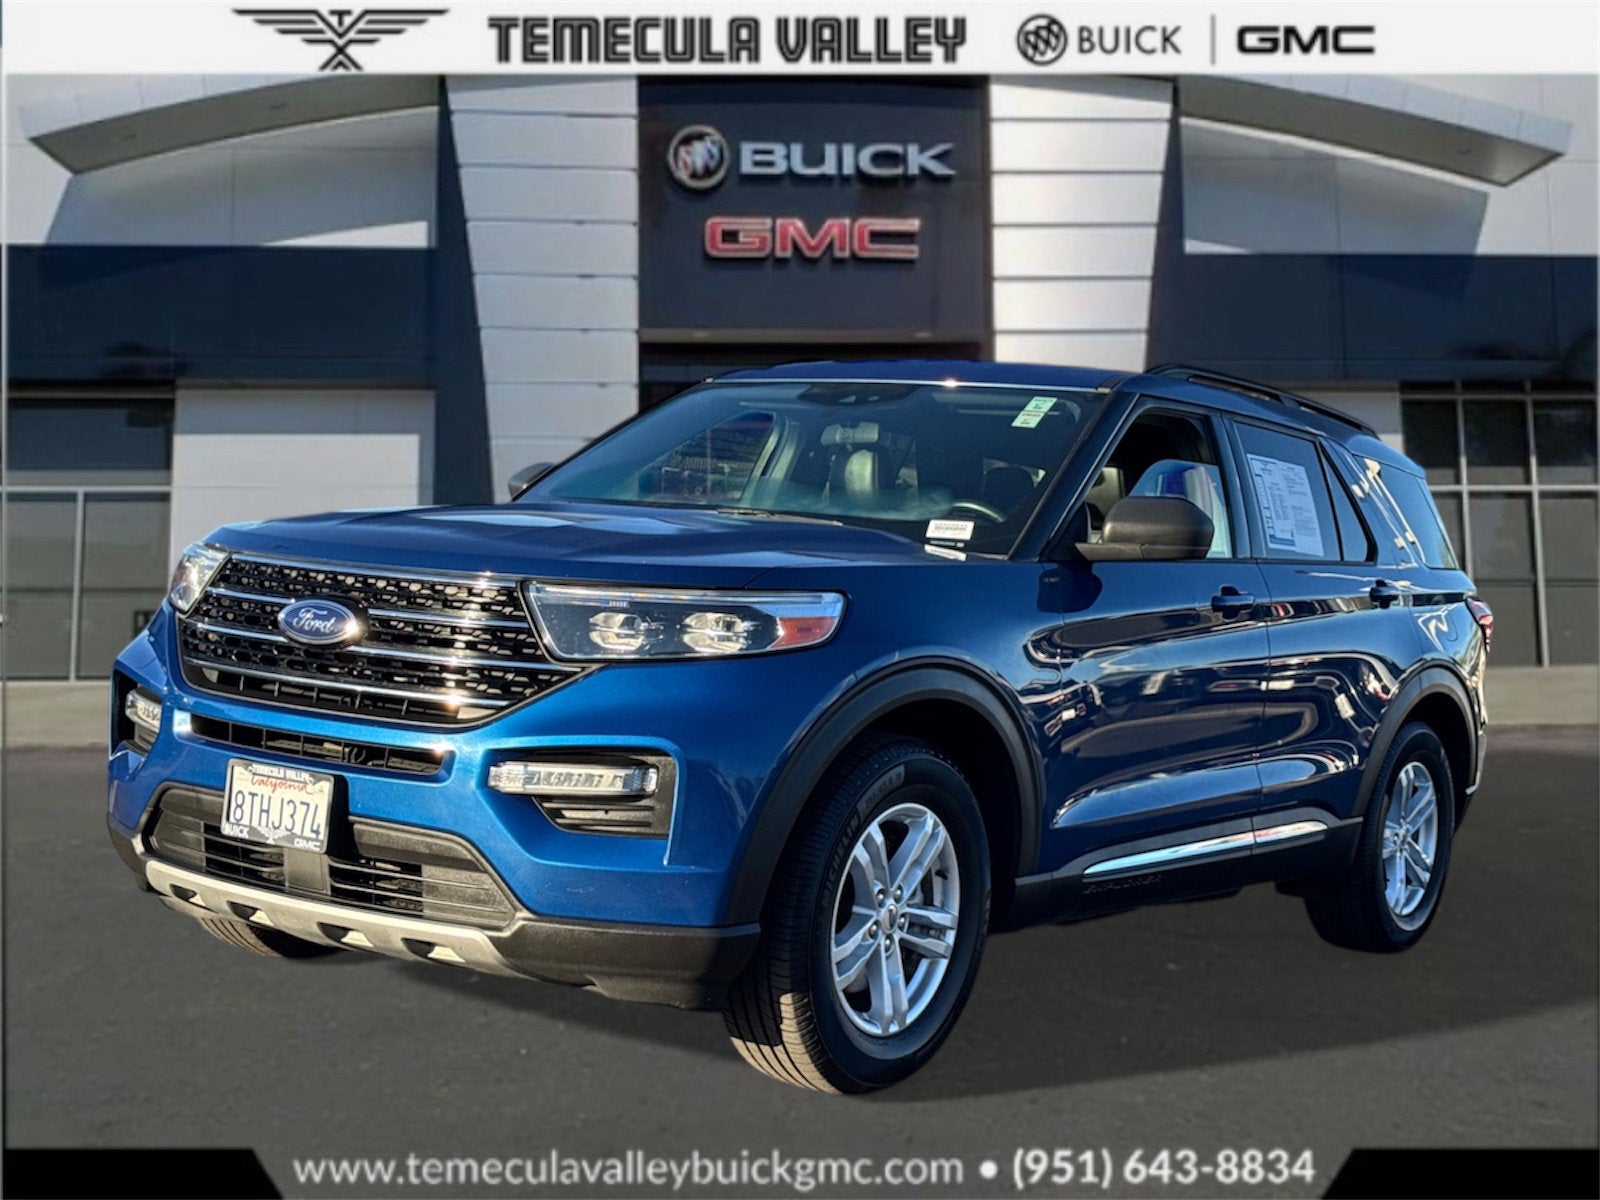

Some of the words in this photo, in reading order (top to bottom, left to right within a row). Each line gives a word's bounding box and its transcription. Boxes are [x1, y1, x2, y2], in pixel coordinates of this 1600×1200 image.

[739, 141, 957, 178] BUICK
[704, 216, 922, 259] GMC
[292, 606, 336, 634] Ford
[233, 790, 322, 839] 8THJ374
[293, 837, 321, 851] GMC
